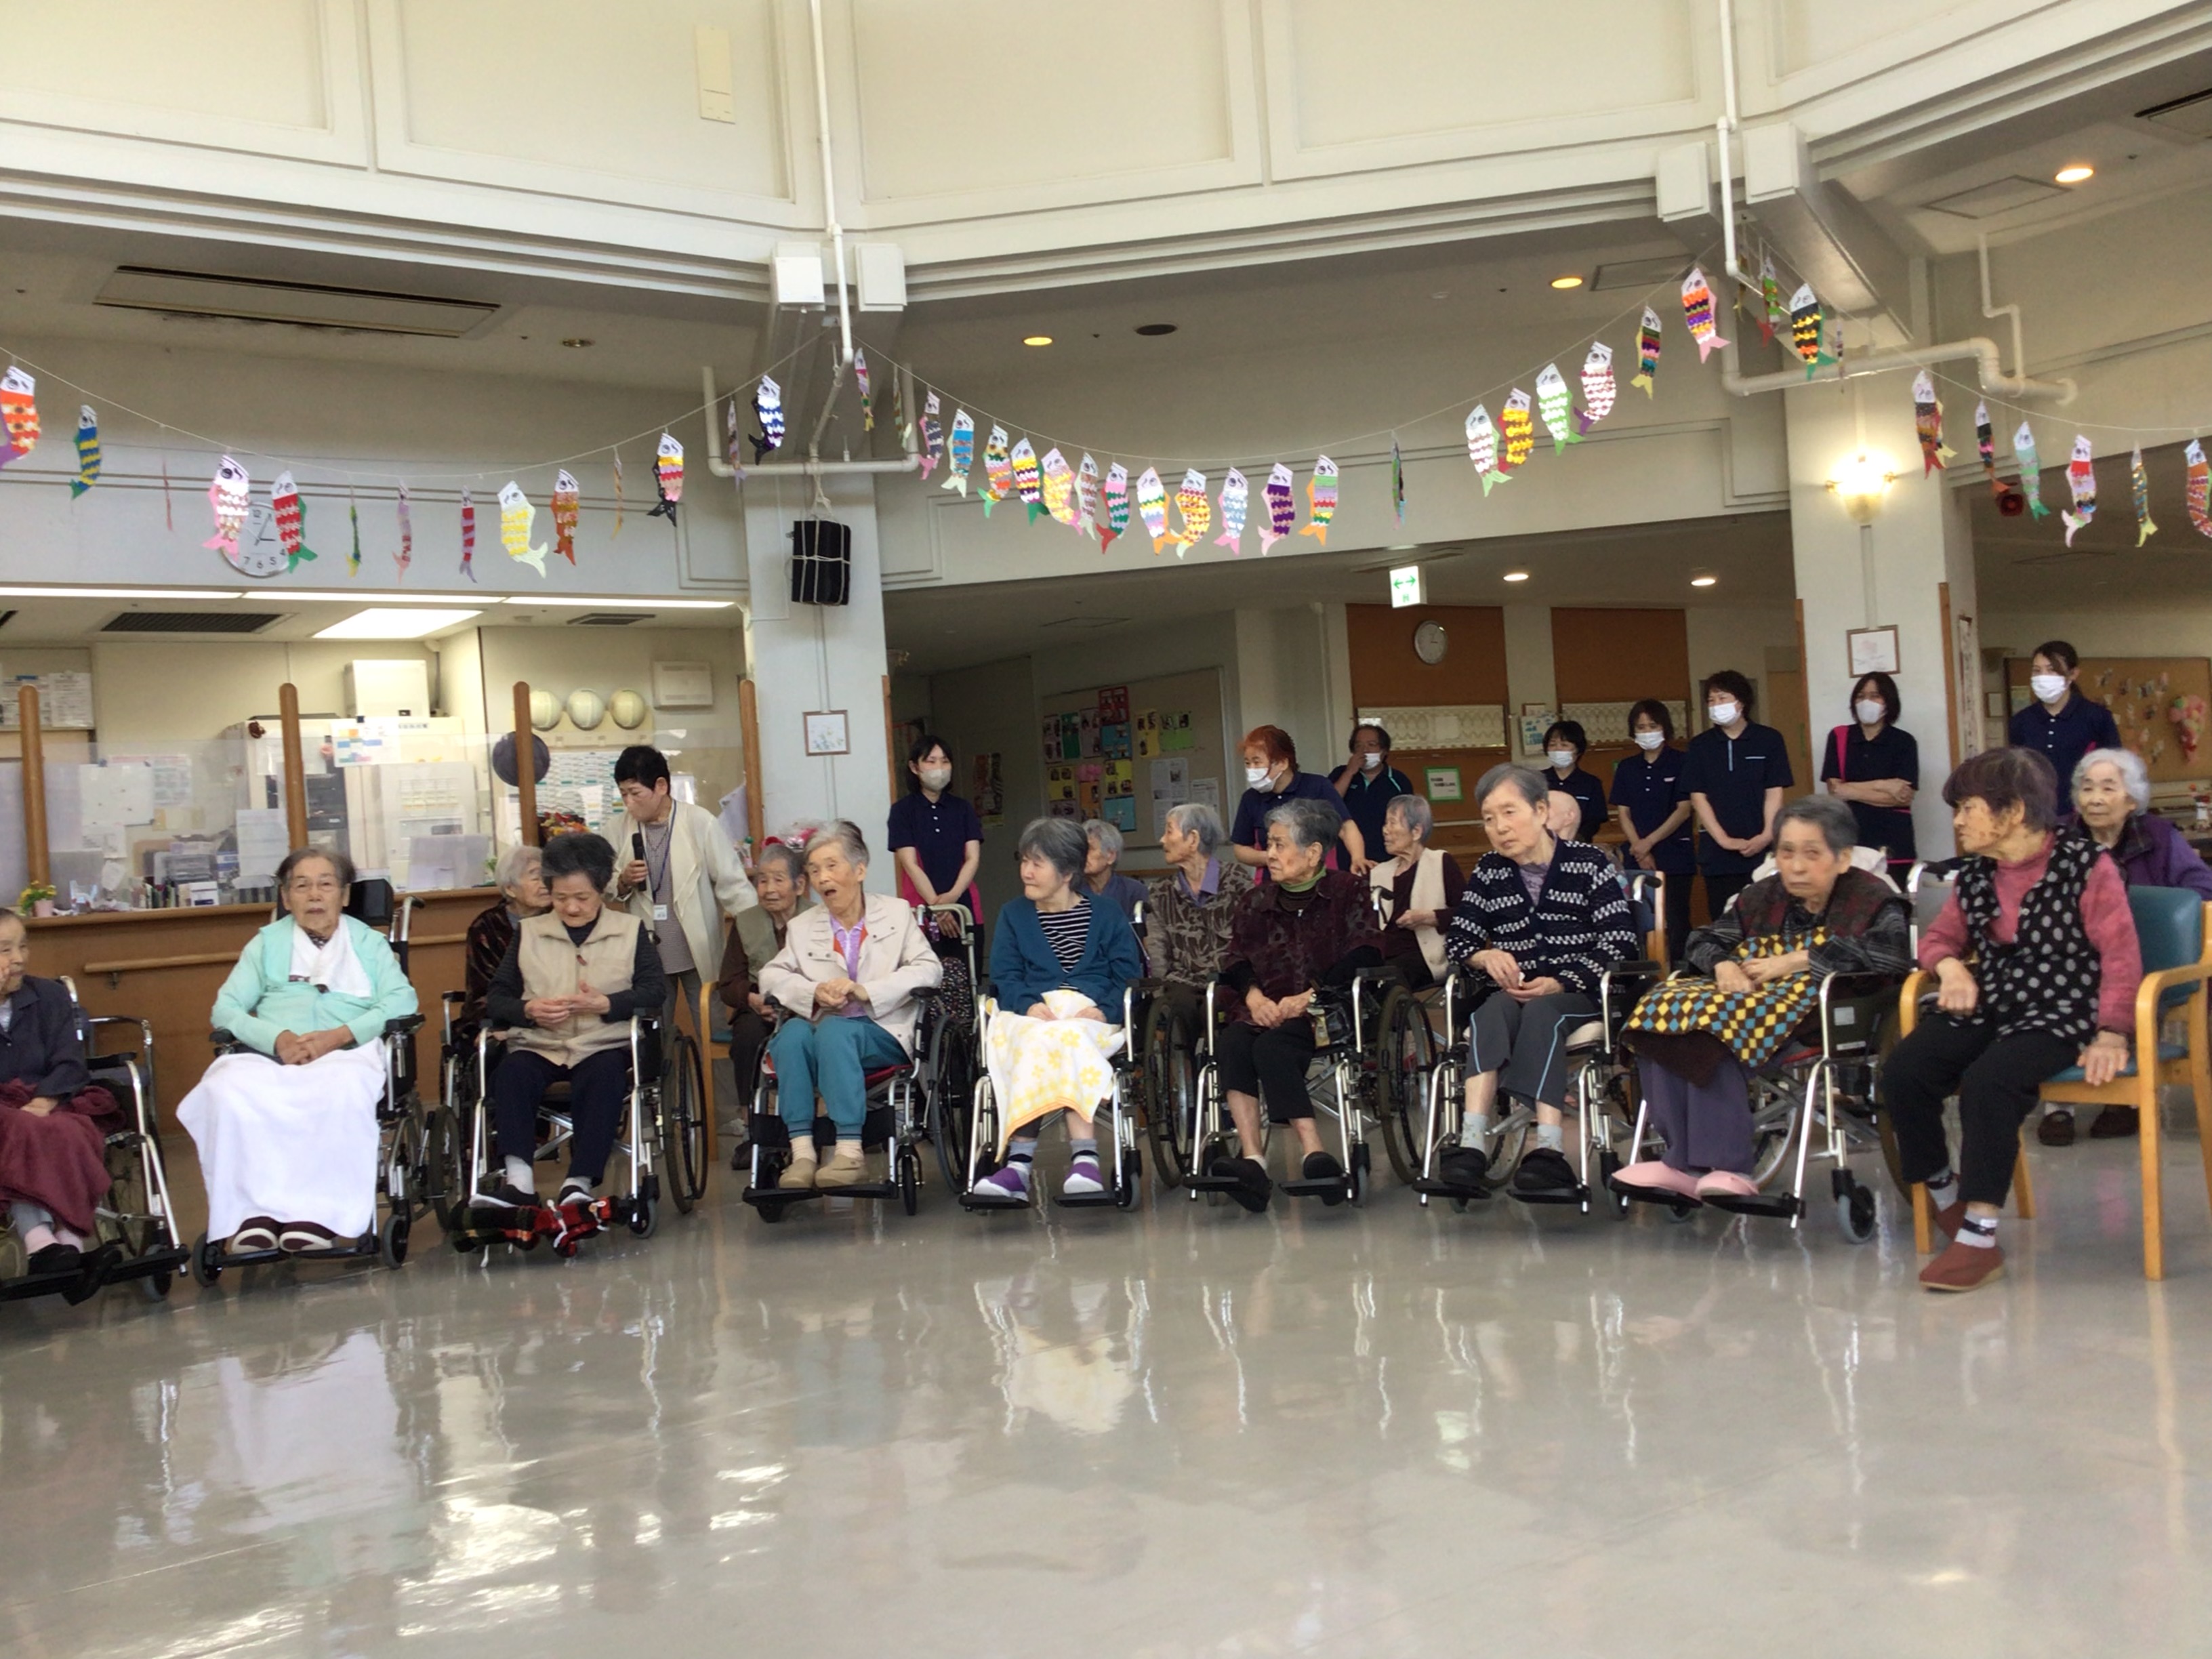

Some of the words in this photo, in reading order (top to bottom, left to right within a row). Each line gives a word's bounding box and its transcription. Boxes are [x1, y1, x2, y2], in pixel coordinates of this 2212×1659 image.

[244, 556, 251, 565] 7
[257, 560, 264, 569] 6
[270, 556, 276, 565] 5
